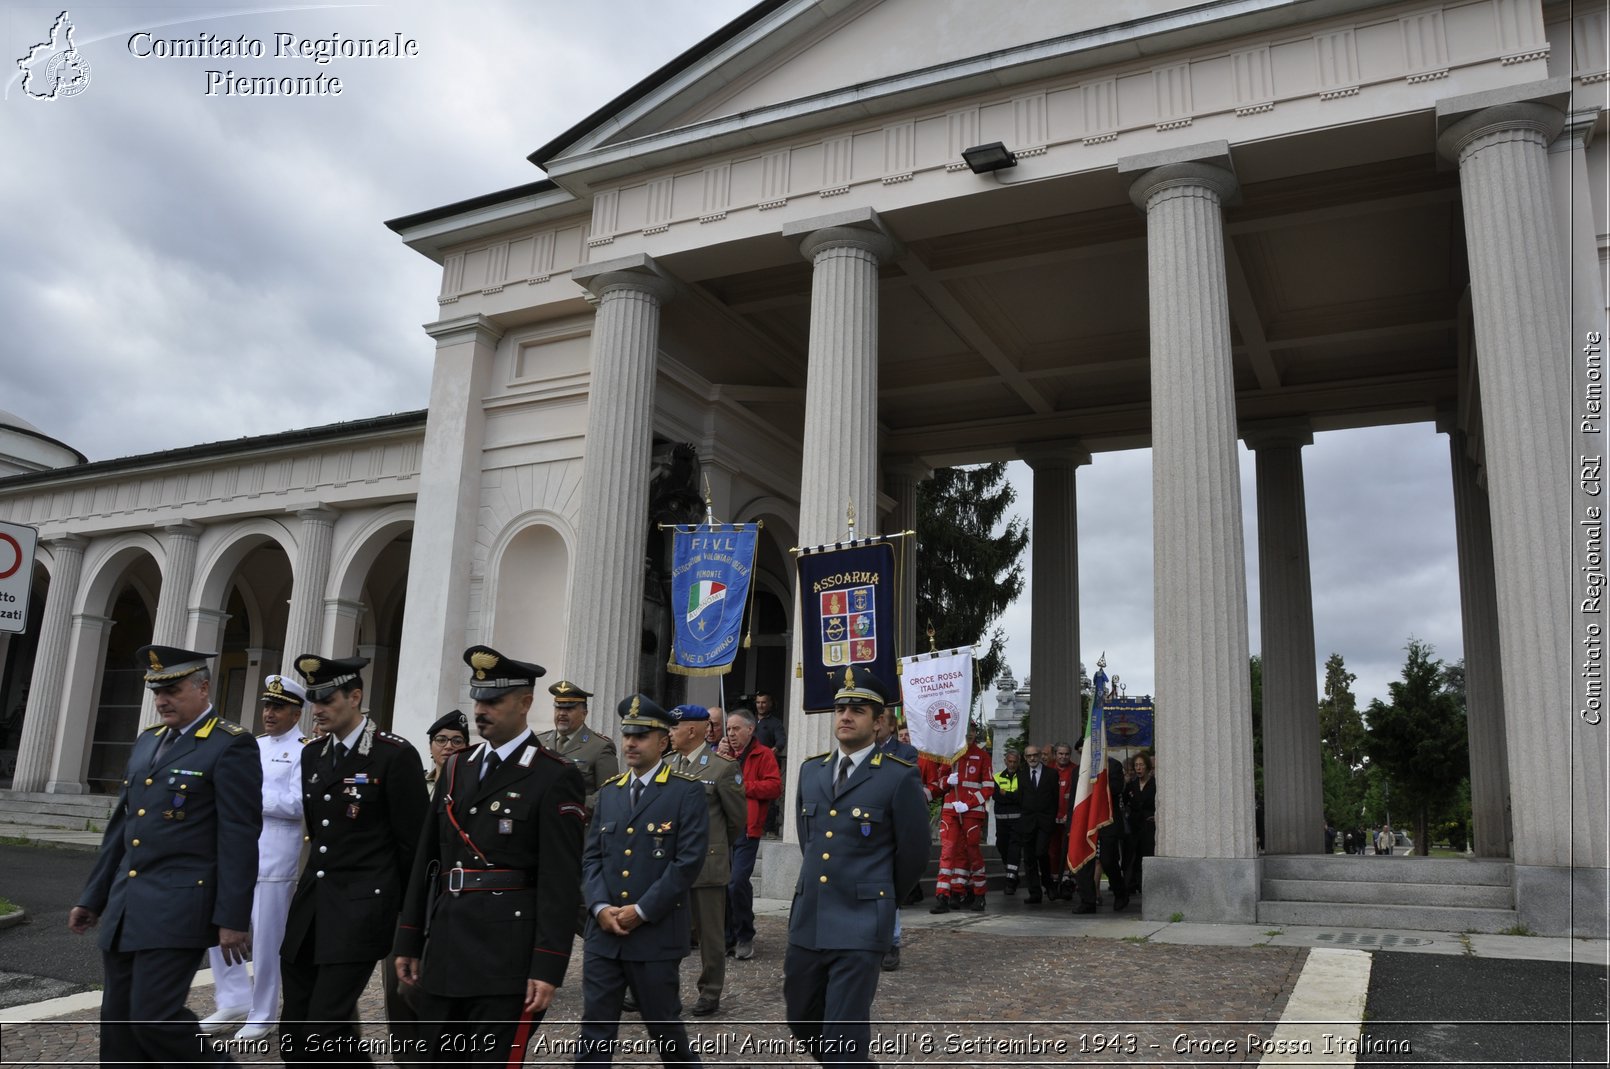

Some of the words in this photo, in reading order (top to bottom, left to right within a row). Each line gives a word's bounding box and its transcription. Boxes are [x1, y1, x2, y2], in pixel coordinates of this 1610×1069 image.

[813, 571, 880, 593] ASSOARMA
[704, 635, 735, 660] TORINO
[909, 676, 935, 686] CROCE
[937, 671, 963, 682] ROSSA
[920, 681, 954, 693] ITALIANA
